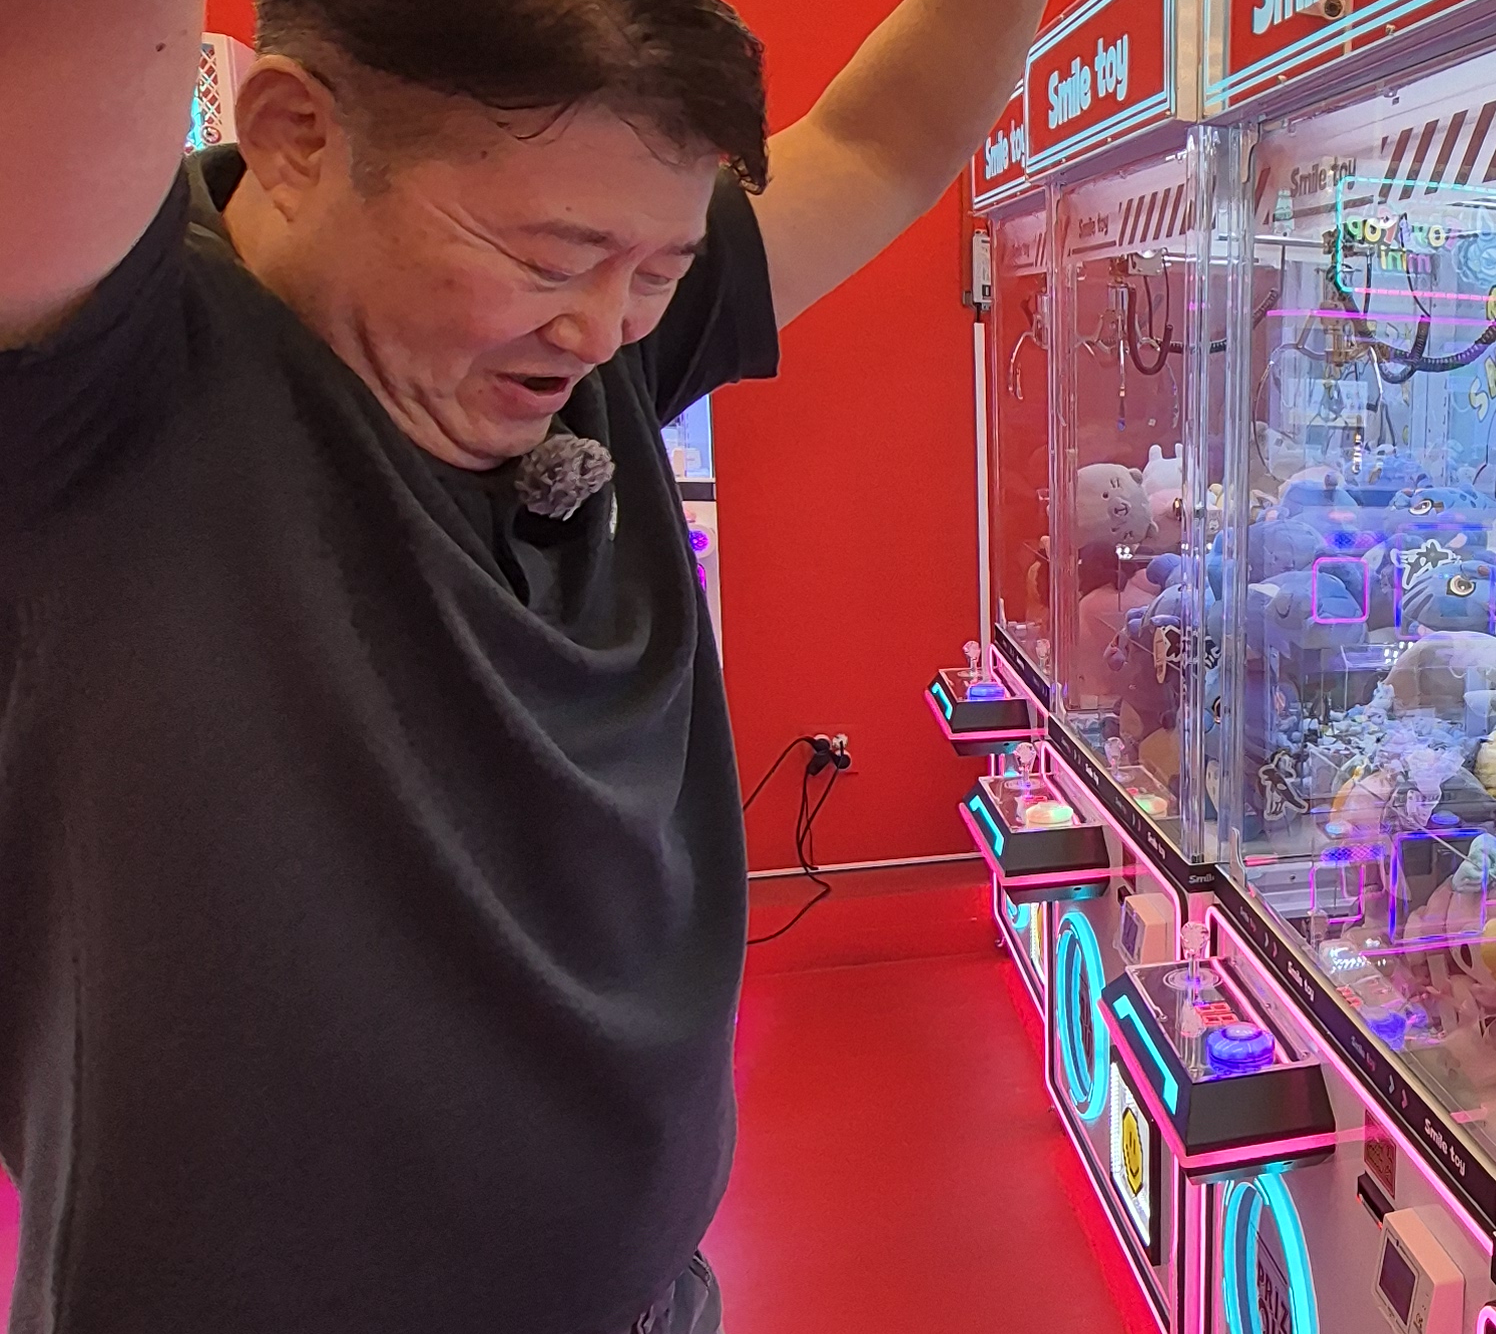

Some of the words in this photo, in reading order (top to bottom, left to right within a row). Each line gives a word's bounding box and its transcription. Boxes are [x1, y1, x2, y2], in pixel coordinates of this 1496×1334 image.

[1047, 55, 1092, 130] Smile
[1094, 33, 1129, 102] toy
[1290, 166, 1327, 197] Smile
[1423, 1117, 1449, 1155] Smile
[1449, 1144, 1466, 1177] toy
